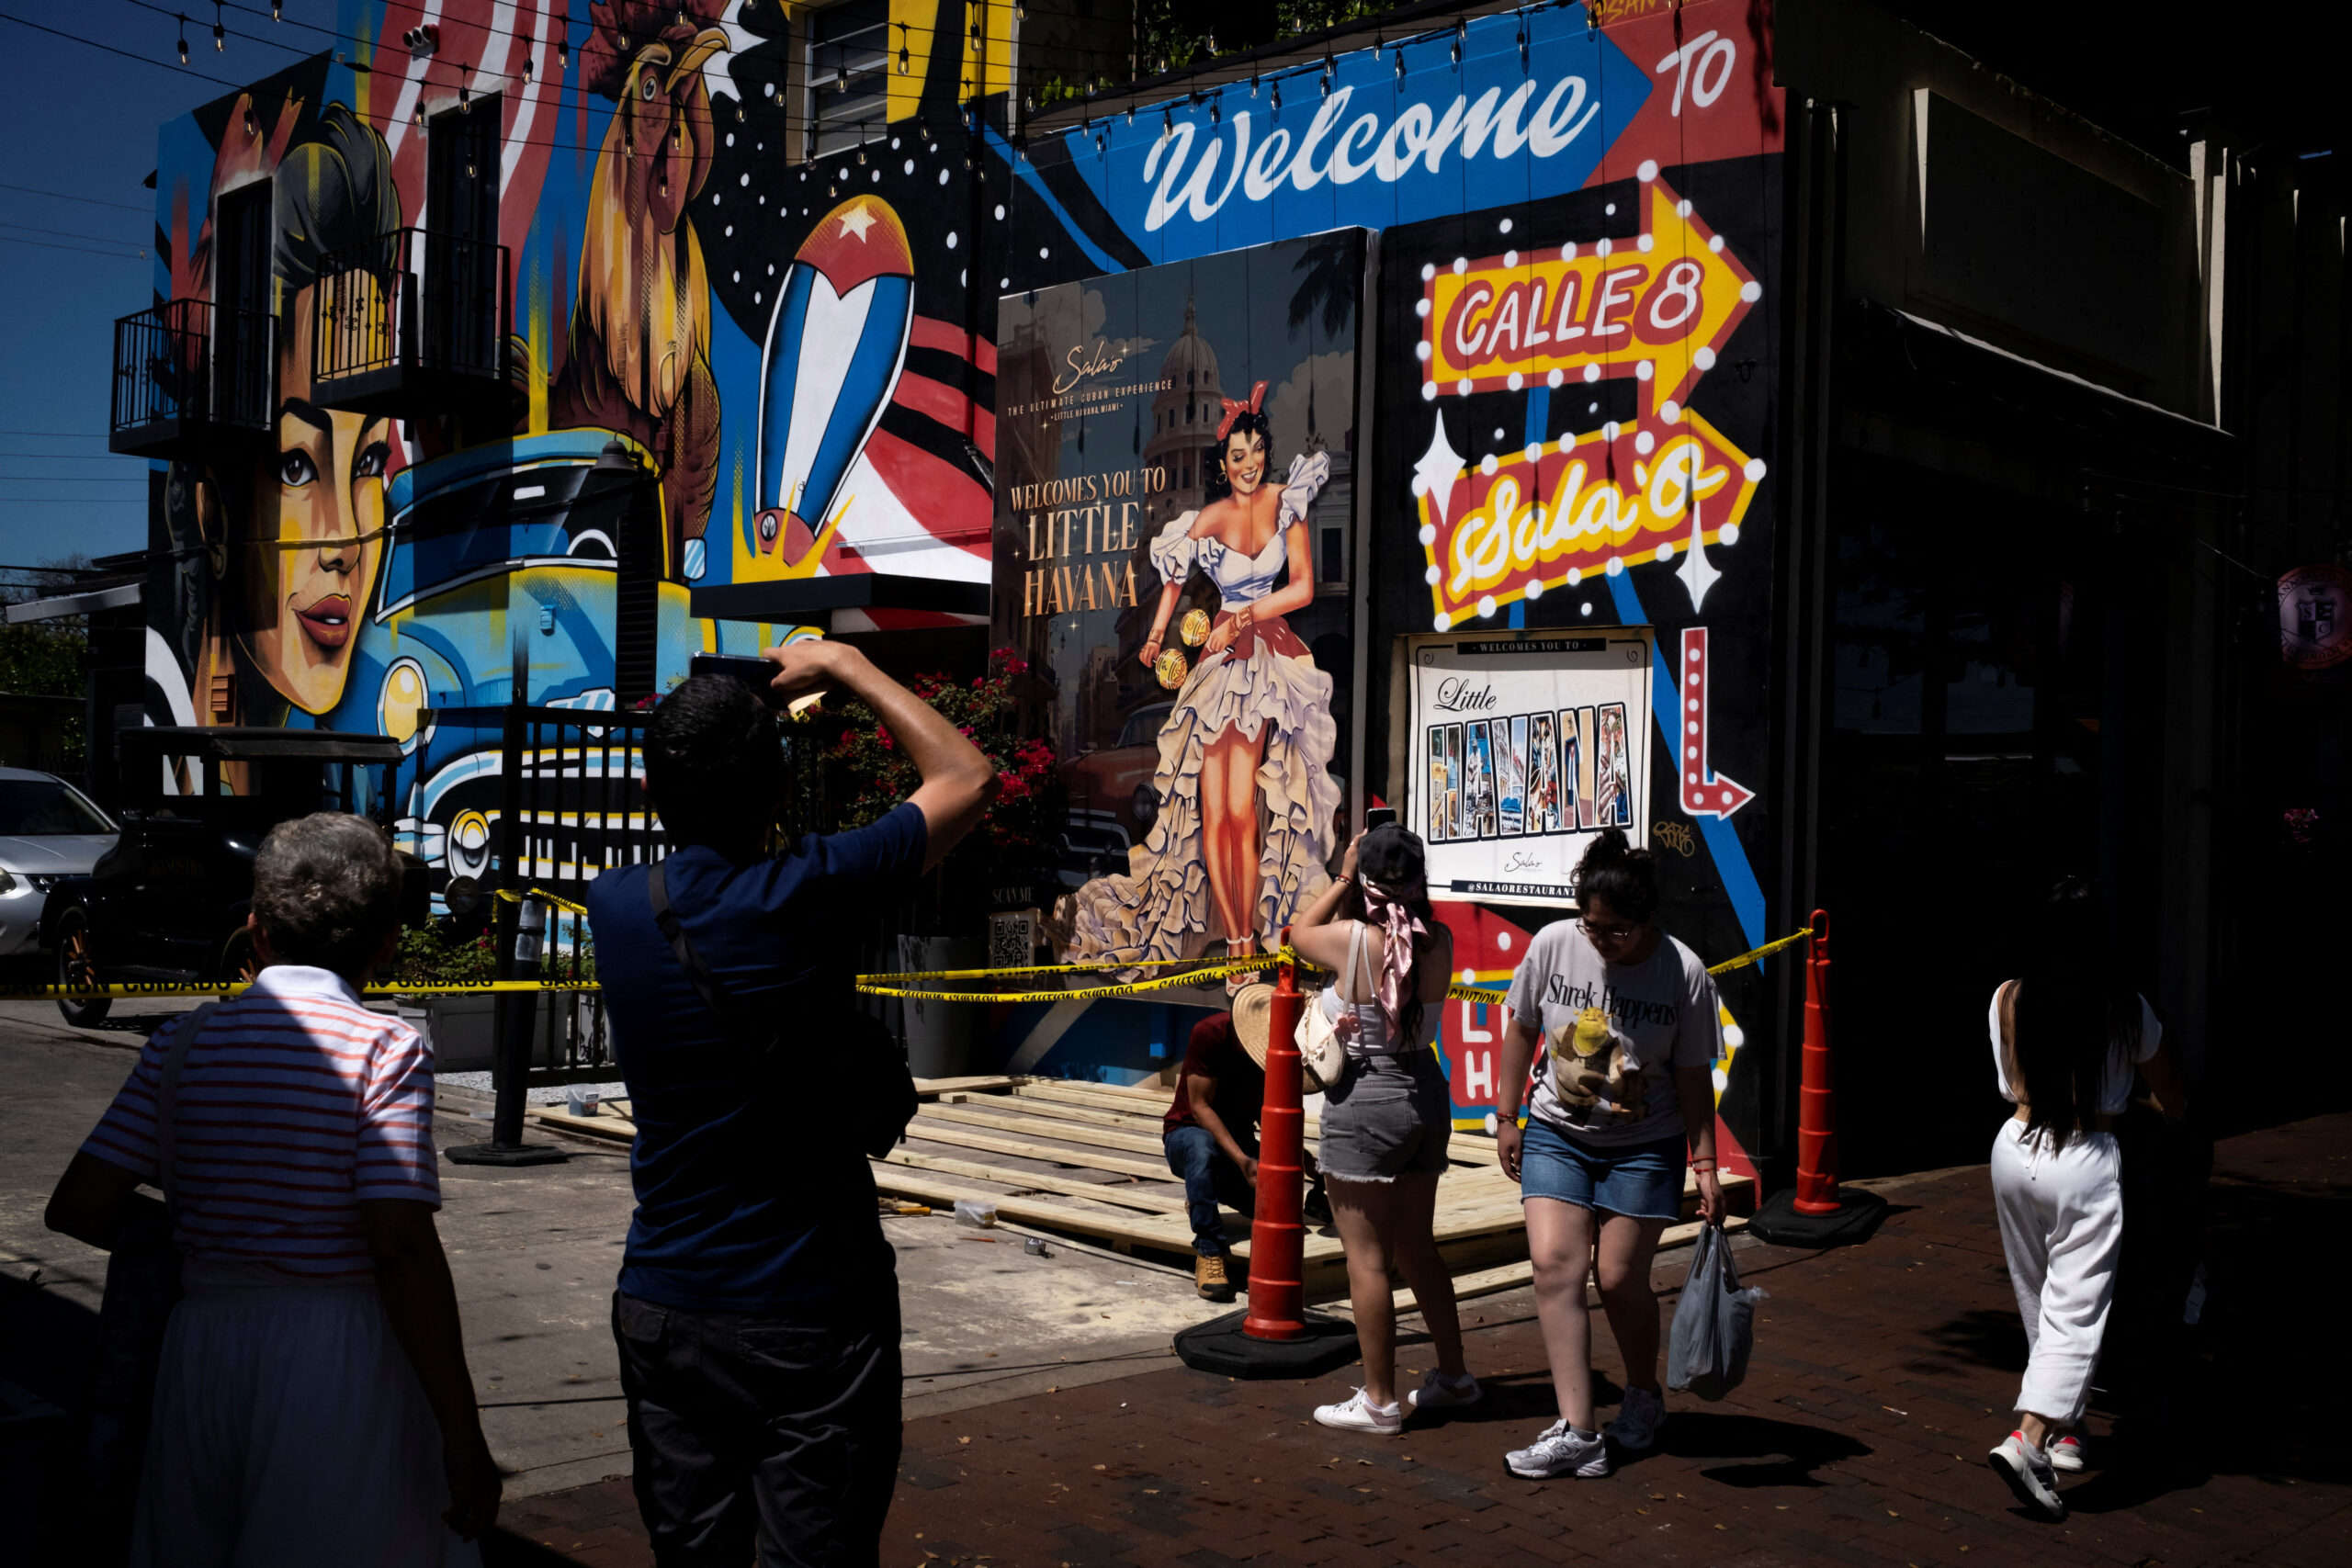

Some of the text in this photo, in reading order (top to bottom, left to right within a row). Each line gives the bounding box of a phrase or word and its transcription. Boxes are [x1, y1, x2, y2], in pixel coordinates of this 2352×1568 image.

[1143, 30, 1736, 231] Welcome TO
[1455, 263, 1700, 356] CALLE 8
[1008, 379, 1172, 417] THE ULTIMATE CUBAN EXPERIENCE
[1054, 408, 1073, 421] LITTLE
[1101, 402, 1120, 413] MIAMI
[1011, 466, 1166, 512] WELCOMES YOU TO
[1028, 502, 1139, 561] LITTLE
[1023, 558, 1138, 617] HAVANA
[1479, 640, 1579, 653] WELCOMES YOU TO
[1433, 677, 1497, 713] Little
[1427, 702, 1634, 845] HAVANA
[992, 886, 1035, 904] SCAN ME
[1447, 987, 1499, 1004] CAUTION
[1547, 974, 1676, 1029] Shrek Happens
